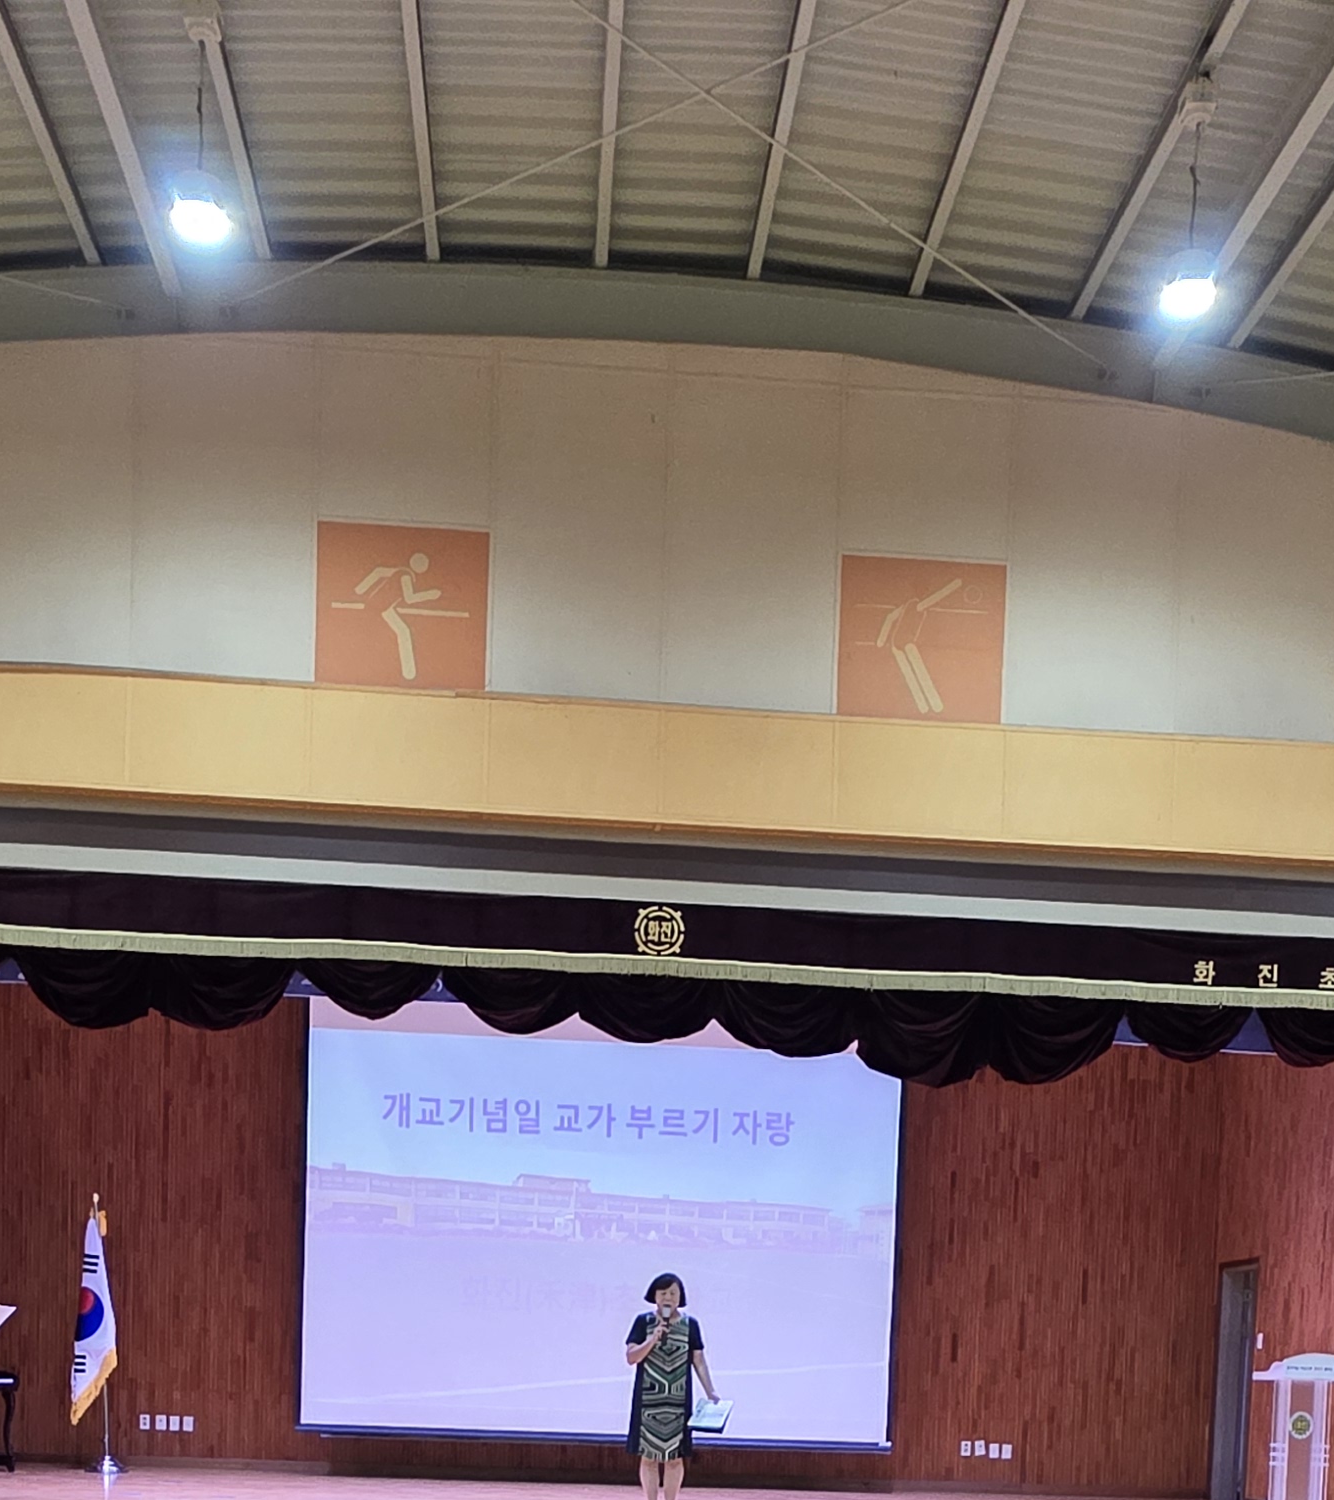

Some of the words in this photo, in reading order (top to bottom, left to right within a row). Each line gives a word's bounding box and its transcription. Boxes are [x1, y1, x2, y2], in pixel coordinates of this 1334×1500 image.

[382, 1091, 542, 1135] 개교기념일
[553, 1103, 616, 1138] 교가
[626, 1104, 720, 1144] 부르기
[731, 1109, 795, 1147] 자랑
